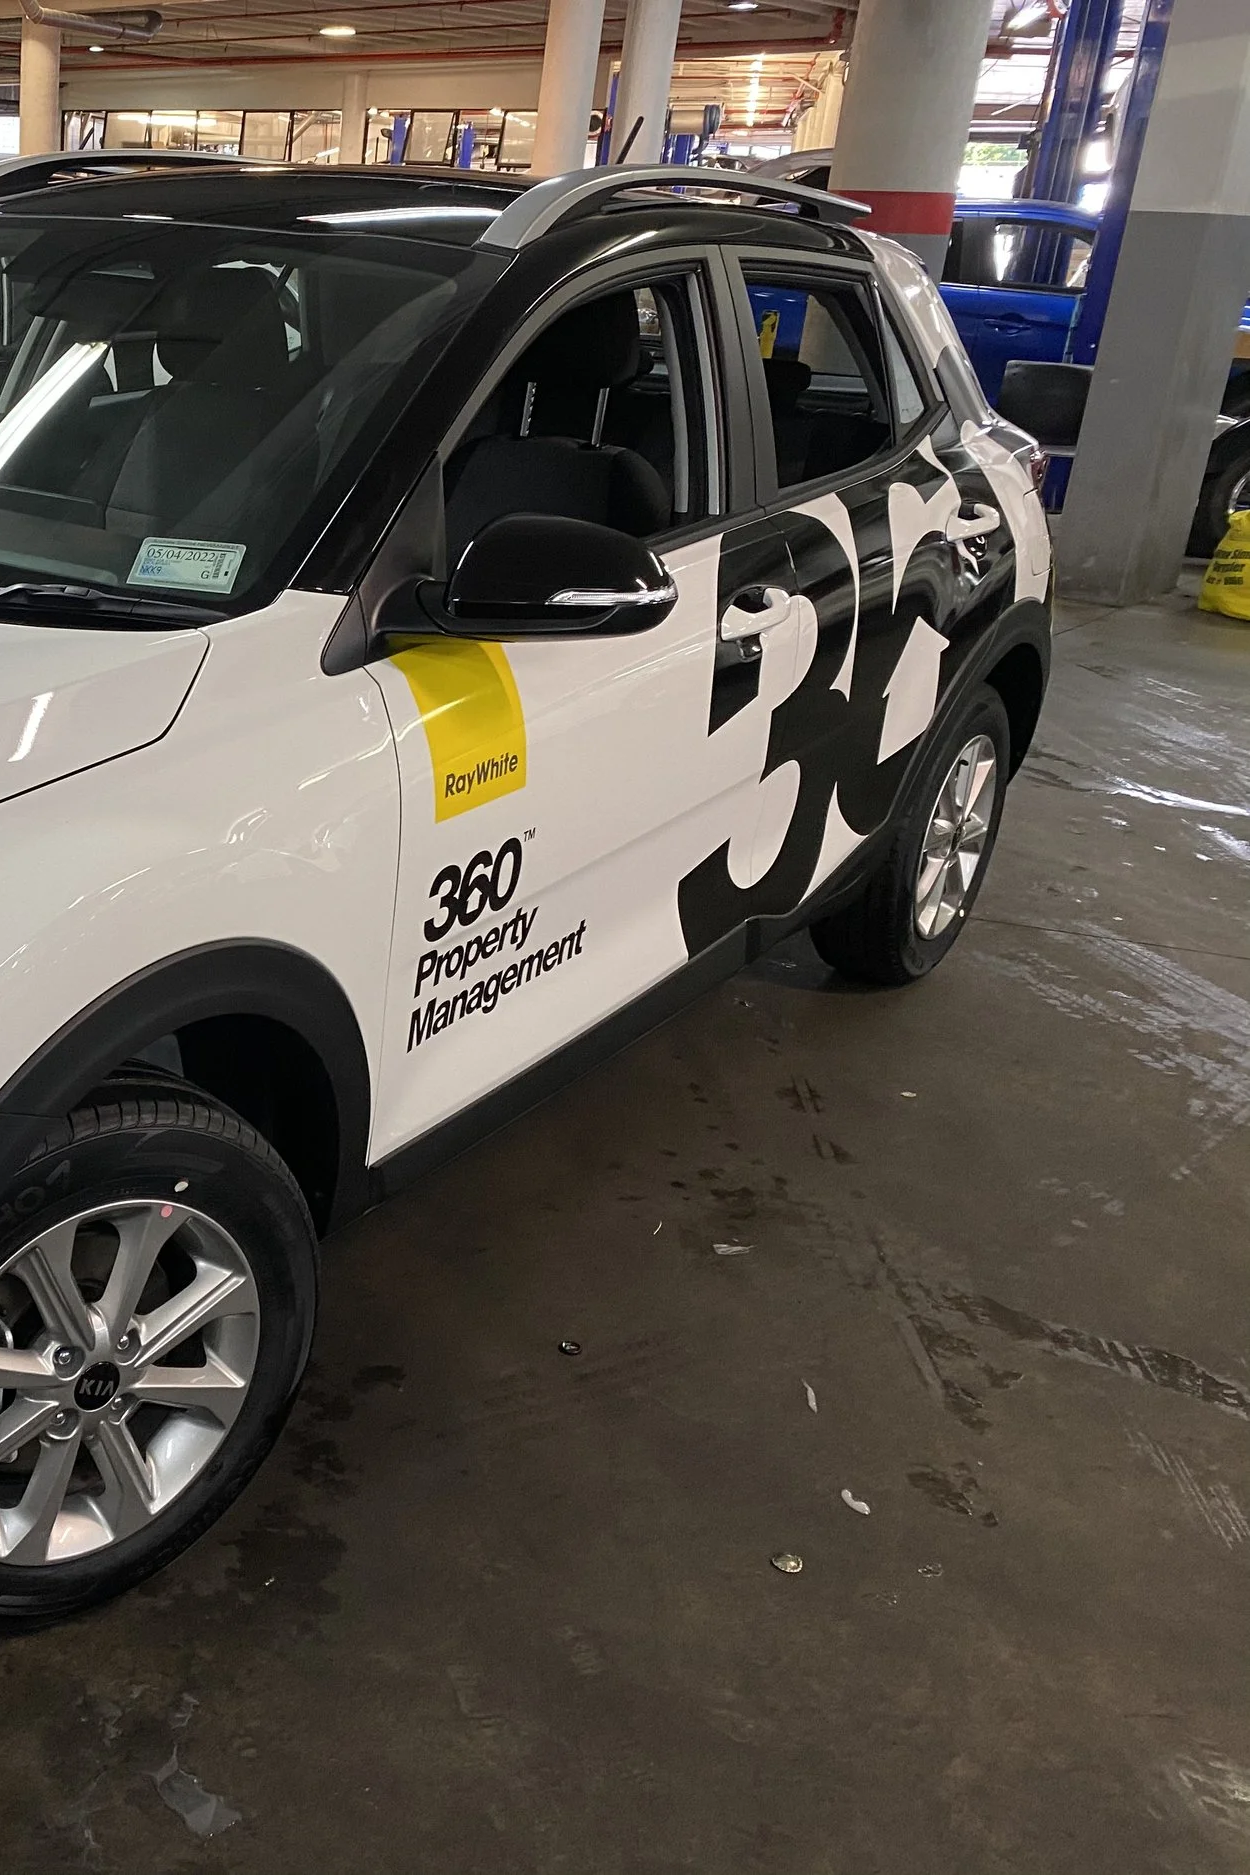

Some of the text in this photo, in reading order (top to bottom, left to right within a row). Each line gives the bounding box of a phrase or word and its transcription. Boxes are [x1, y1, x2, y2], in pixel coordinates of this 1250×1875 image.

[147, 547, 215, 562] 05/04/2022
[445, 752, 518, 798] RayWhite
[423, 837, 522, 942] 360
[406, 919, 587, 1054] Management
[414, 905, 539, 999] Property
[79, 1378, 115, 1396] KIA
